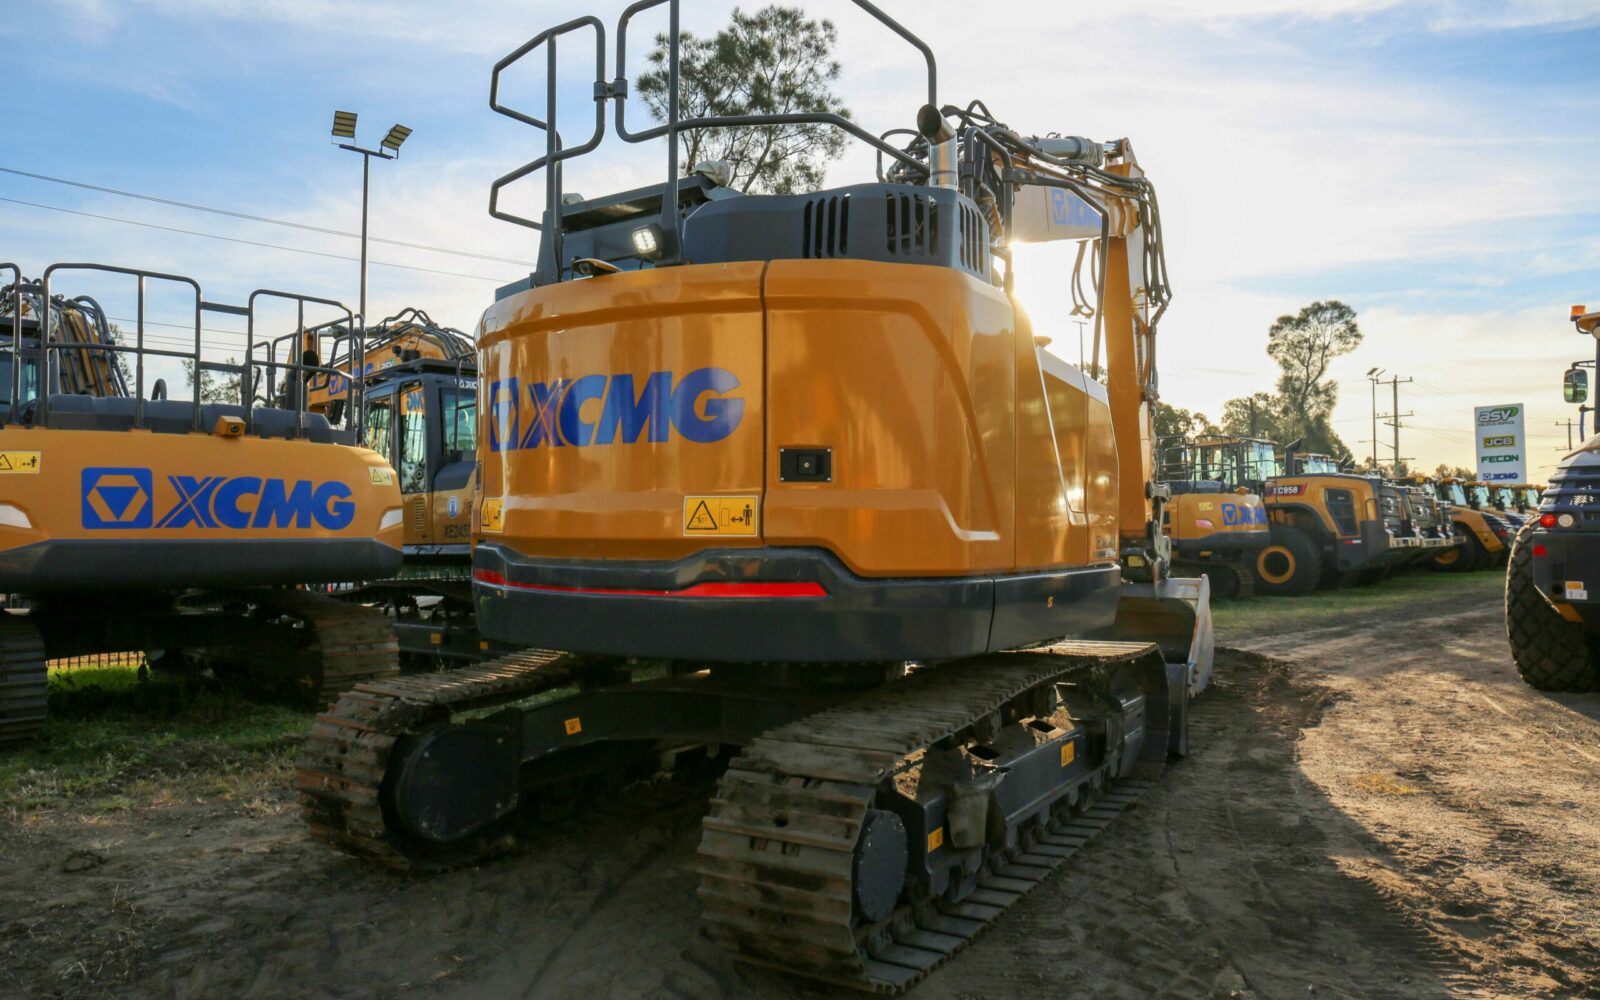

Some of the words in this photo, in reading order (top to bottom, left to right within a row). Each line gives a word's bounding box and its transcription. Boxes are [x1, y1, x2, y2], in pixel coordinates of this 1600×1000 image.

[519, 367, 745, 449] XCMG
[1487, 438, 1513, 446] JCB
[1481, 455, 1519, 463] FECON
[154, 476, 355, 530] XCMG
